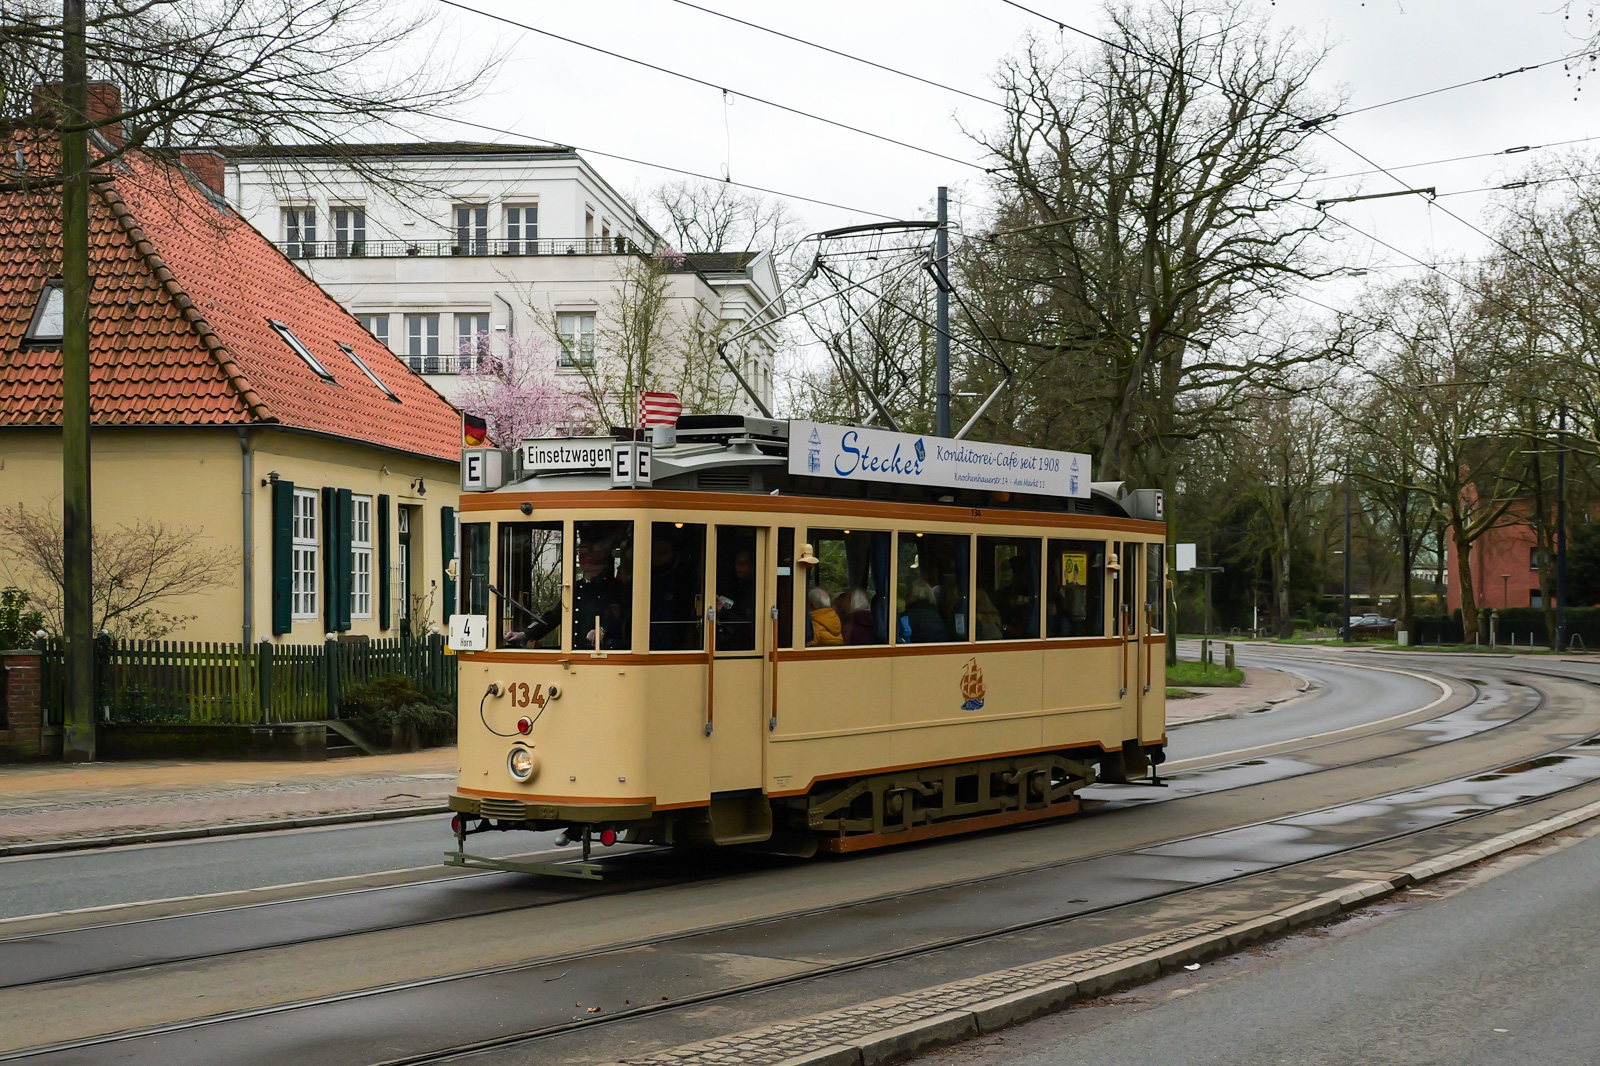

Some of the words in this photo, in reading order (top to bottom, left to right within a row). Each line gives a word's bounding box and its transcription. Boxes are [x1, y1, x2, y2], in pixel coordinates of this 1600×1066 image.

[528, 446, 611, 467] Einsetzwagen
[617, 450, 629, 477] E
[638, 451, 649, 477] E
[834, 430, 924, 477] Stecker
[936, 445, 1019, 471] Konditorei-Café
[1019, 455, 1038, 471] seit
[1038, 457, 1060, 473] 1908
[468, 457, 480, 482] E
[1157, 495, 1162, 514] E
[463, 618, 471, 637] 4
[507, 682, 545, 708] 134
